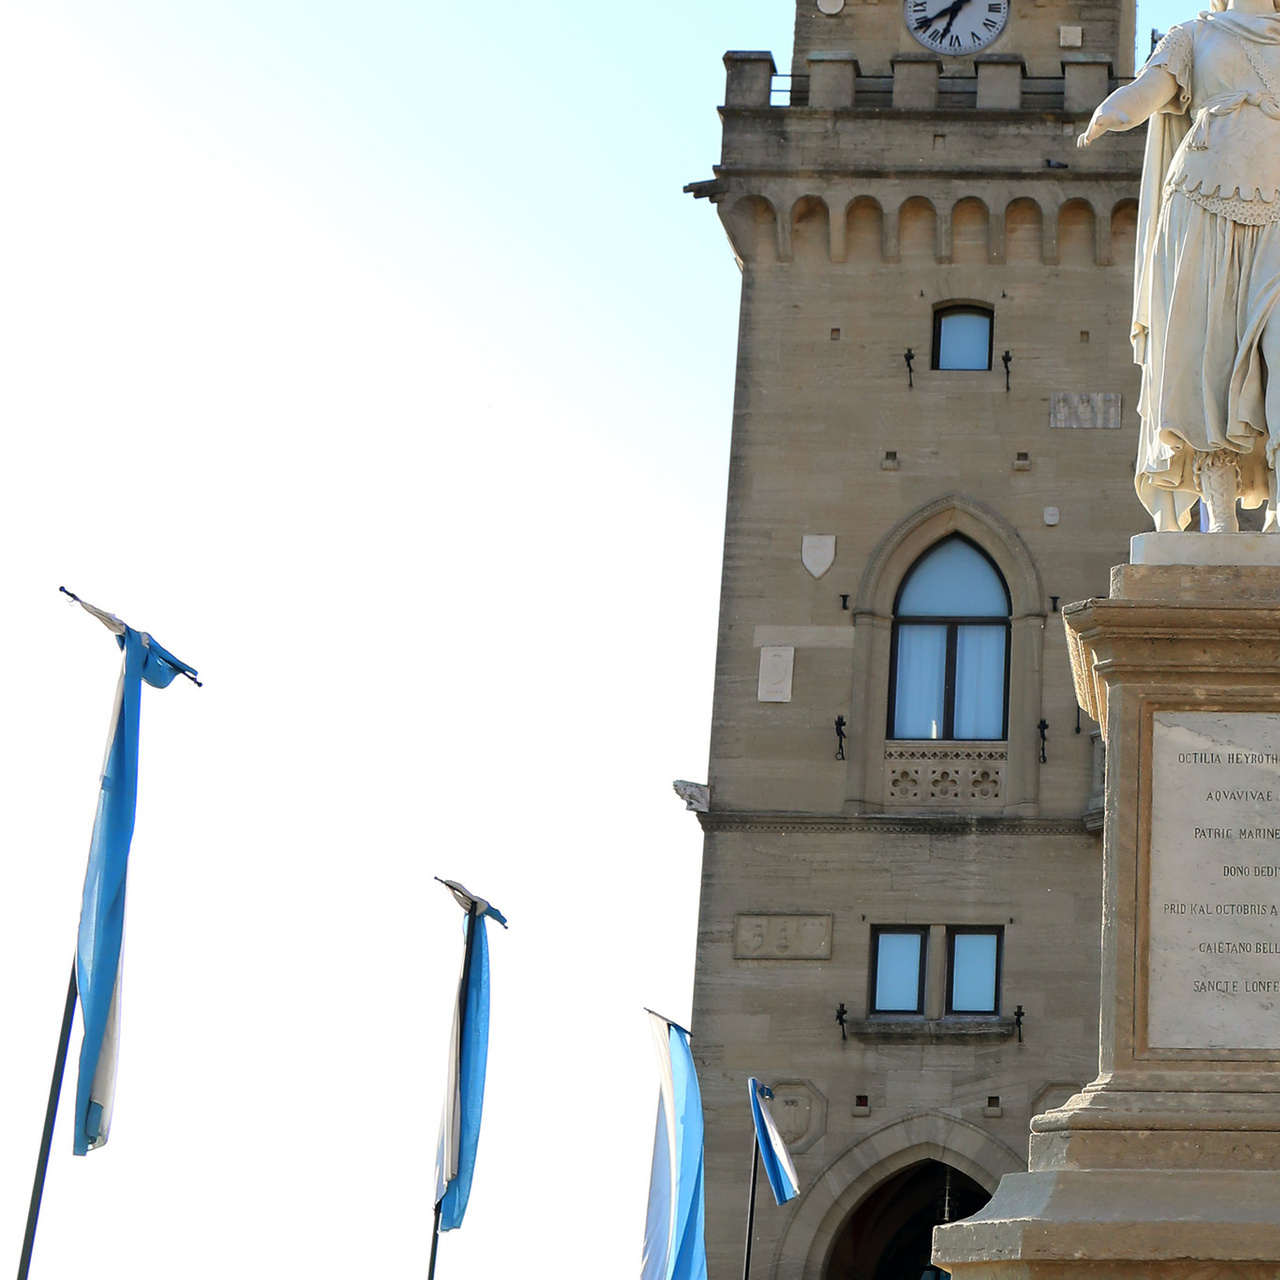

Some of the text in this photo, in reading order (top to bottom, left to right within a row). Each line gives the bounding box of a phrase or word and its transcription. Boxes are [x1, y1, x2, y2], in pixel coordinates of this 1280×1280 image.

[913, 1, 927, 13] IX
[988, 3, 1002, 13] III
[949, 35, 961, 47] VI
[971, 31, 982, 44] V
[1178, 753, 1221, 765] OCTILIA
[1228, 753, 1278, 765] HEYROTH
[1206, 790, 1273, 802] AQVAVIVAE
[1194, 828, 1232, 839] PATRIC
[1223, 865, 1250, 877] DONO
[1163, 903, 1187, 915] PRID
[1190, 904, 1212, 915] KAL
[1215, 904, 1267, 916] OCTOBRIS
[1270, 905, 1279, 916] A
[1199, 942, 1251, 954] CAIETANO
[1193, 980, 1238, 993] SANCTE
